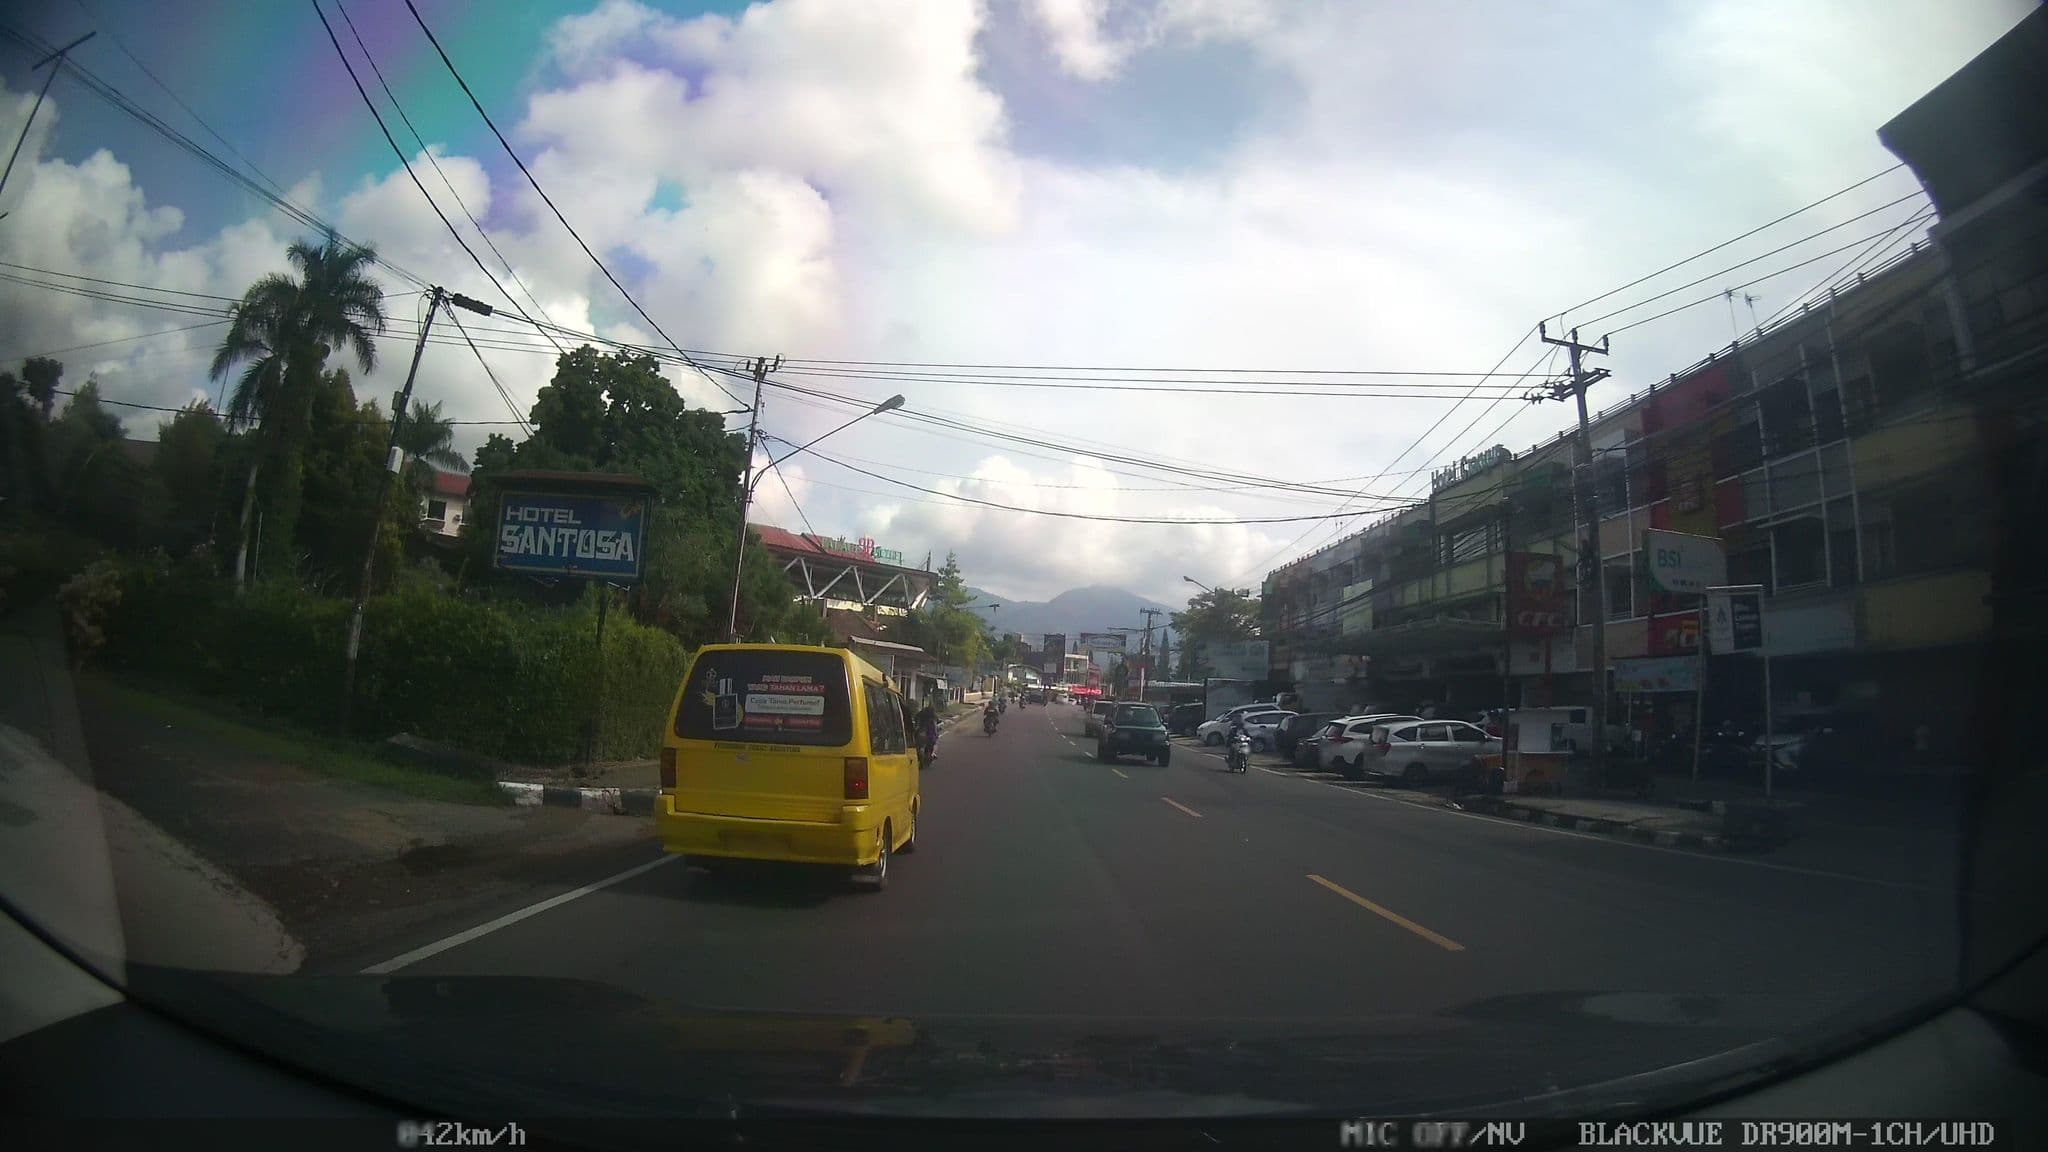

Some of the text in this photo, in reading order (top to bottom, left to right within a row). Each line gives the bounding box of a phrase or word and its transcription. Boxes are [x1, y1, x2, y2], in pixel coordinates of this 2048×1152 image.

[506, 506, 581, 524] HOTEL
[500, 524, 634, 562] SANTOSA
[1657, 549, 1681, 567] BSI
